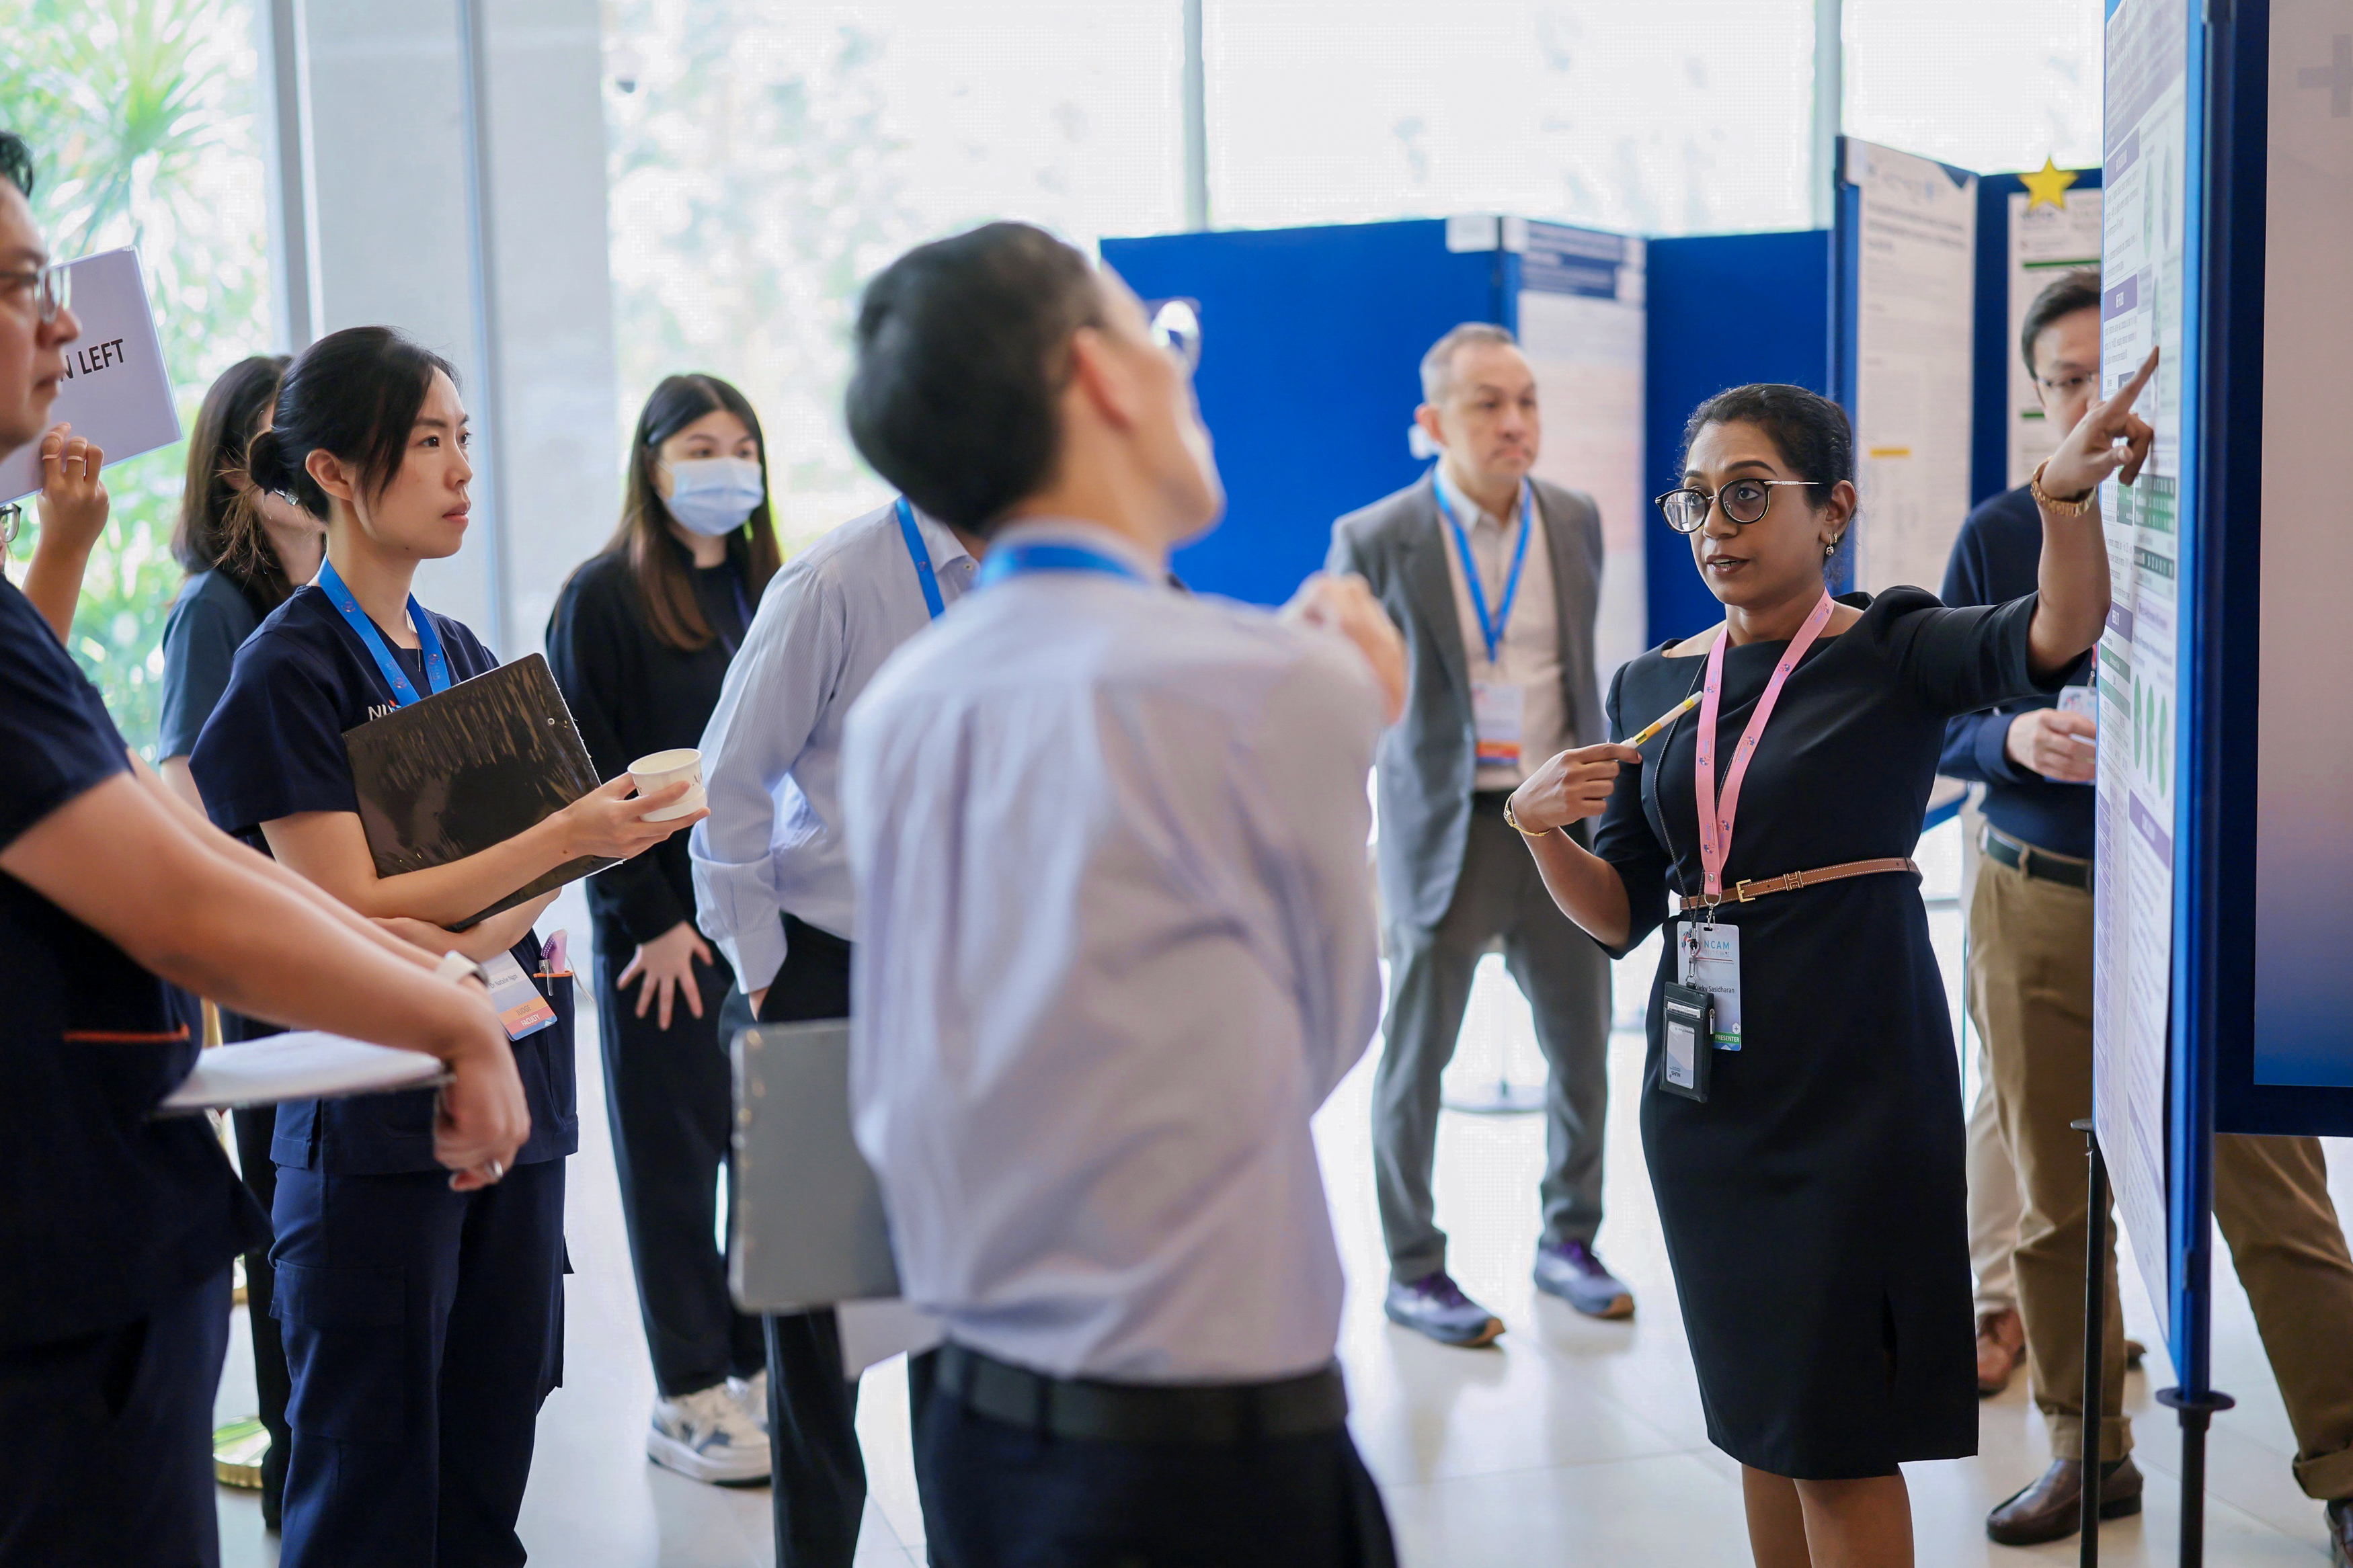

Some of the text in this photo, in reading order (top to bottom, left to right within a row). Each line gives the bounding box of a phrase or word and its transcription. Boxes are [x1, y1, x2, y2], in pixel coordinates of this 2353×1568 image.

[78, 338, 124, 374] LEFT
[1704, 940, 1730, 950] NCAM
[1708, 985, 1735, 993] Sasidharan
[516, 1004, 531, 1016] JUDGE
[520, 1014, 541, 1026] FACULTY
